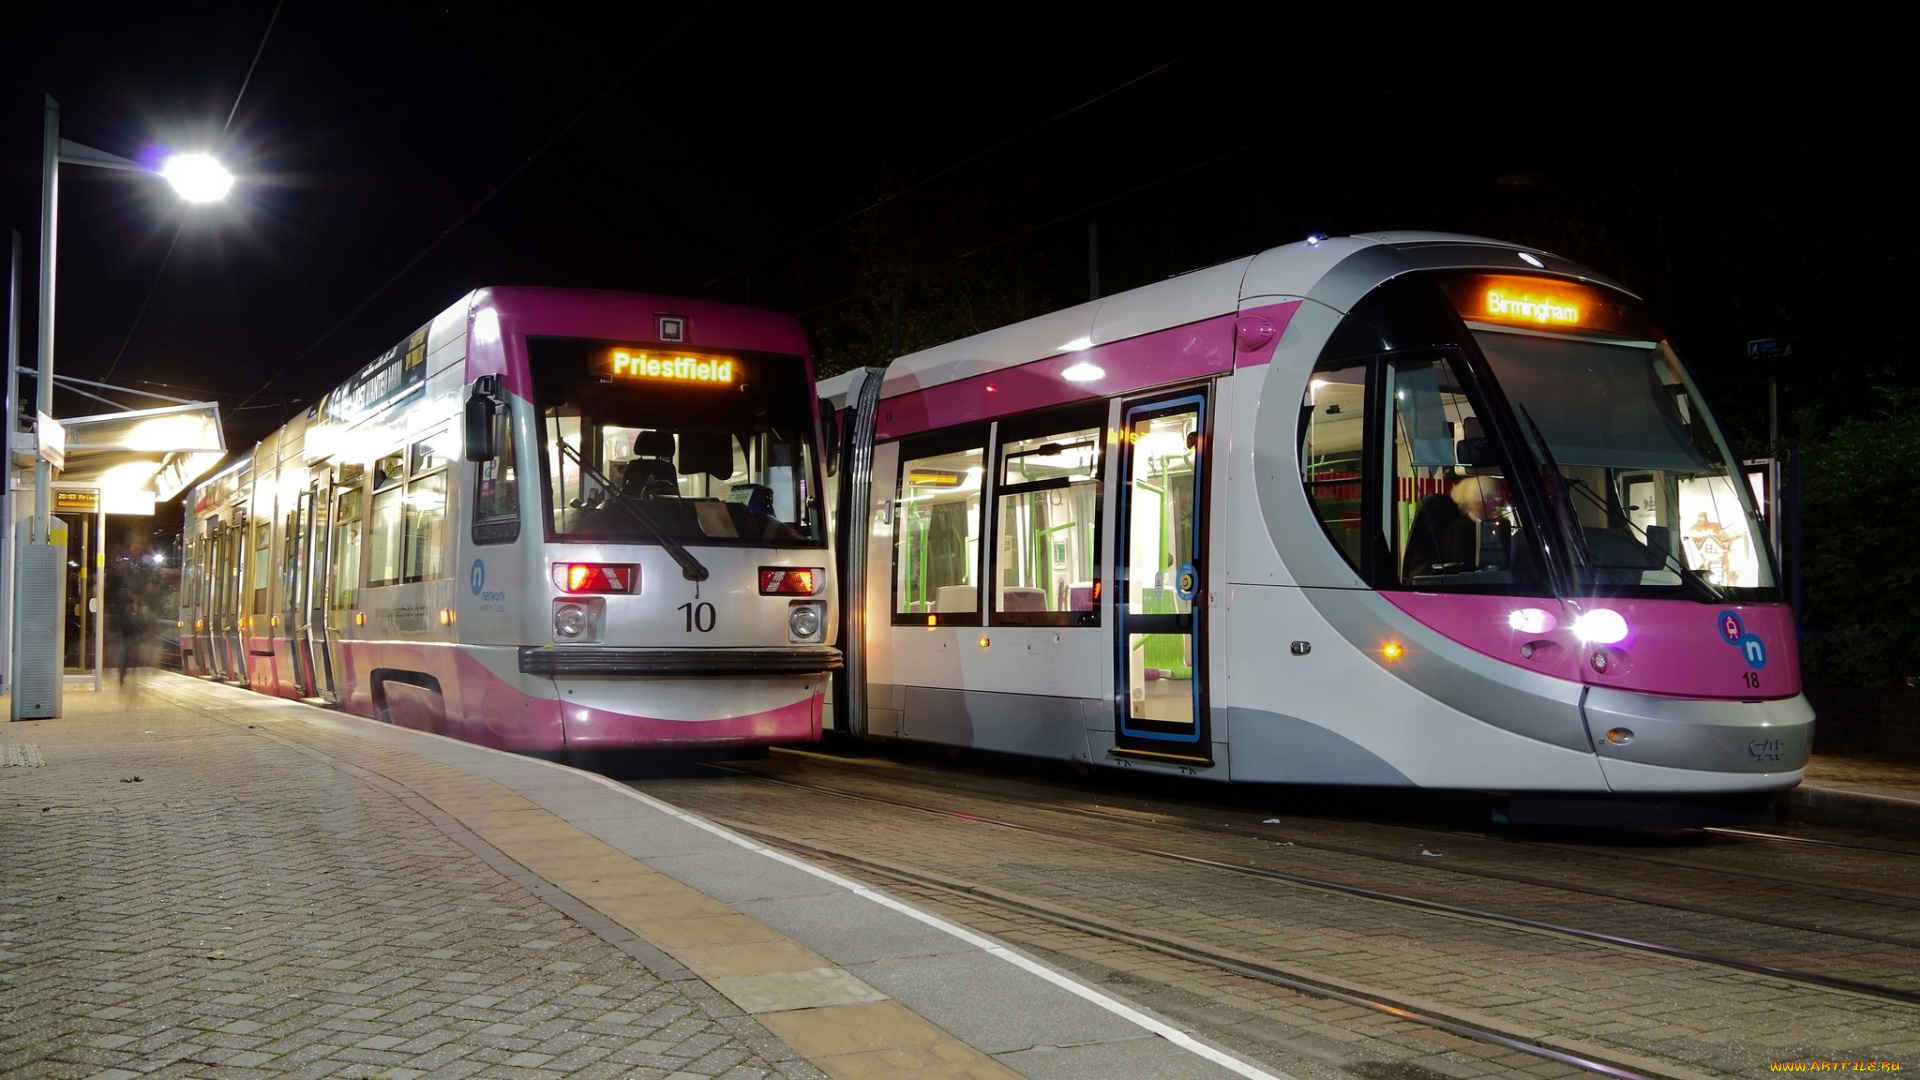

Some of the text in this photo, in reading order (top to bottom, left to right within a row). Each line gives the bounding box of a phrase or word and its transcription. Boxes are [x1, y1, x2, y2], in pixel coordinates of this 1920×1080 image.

[1488, 292, 1578, 323] Birmingham
[614, 352, 732, 382] Priestfield
[481, 591, 506, 602] network
[677, 602, 716, 632] 10
[1743, 672, 1760, 688] 18
